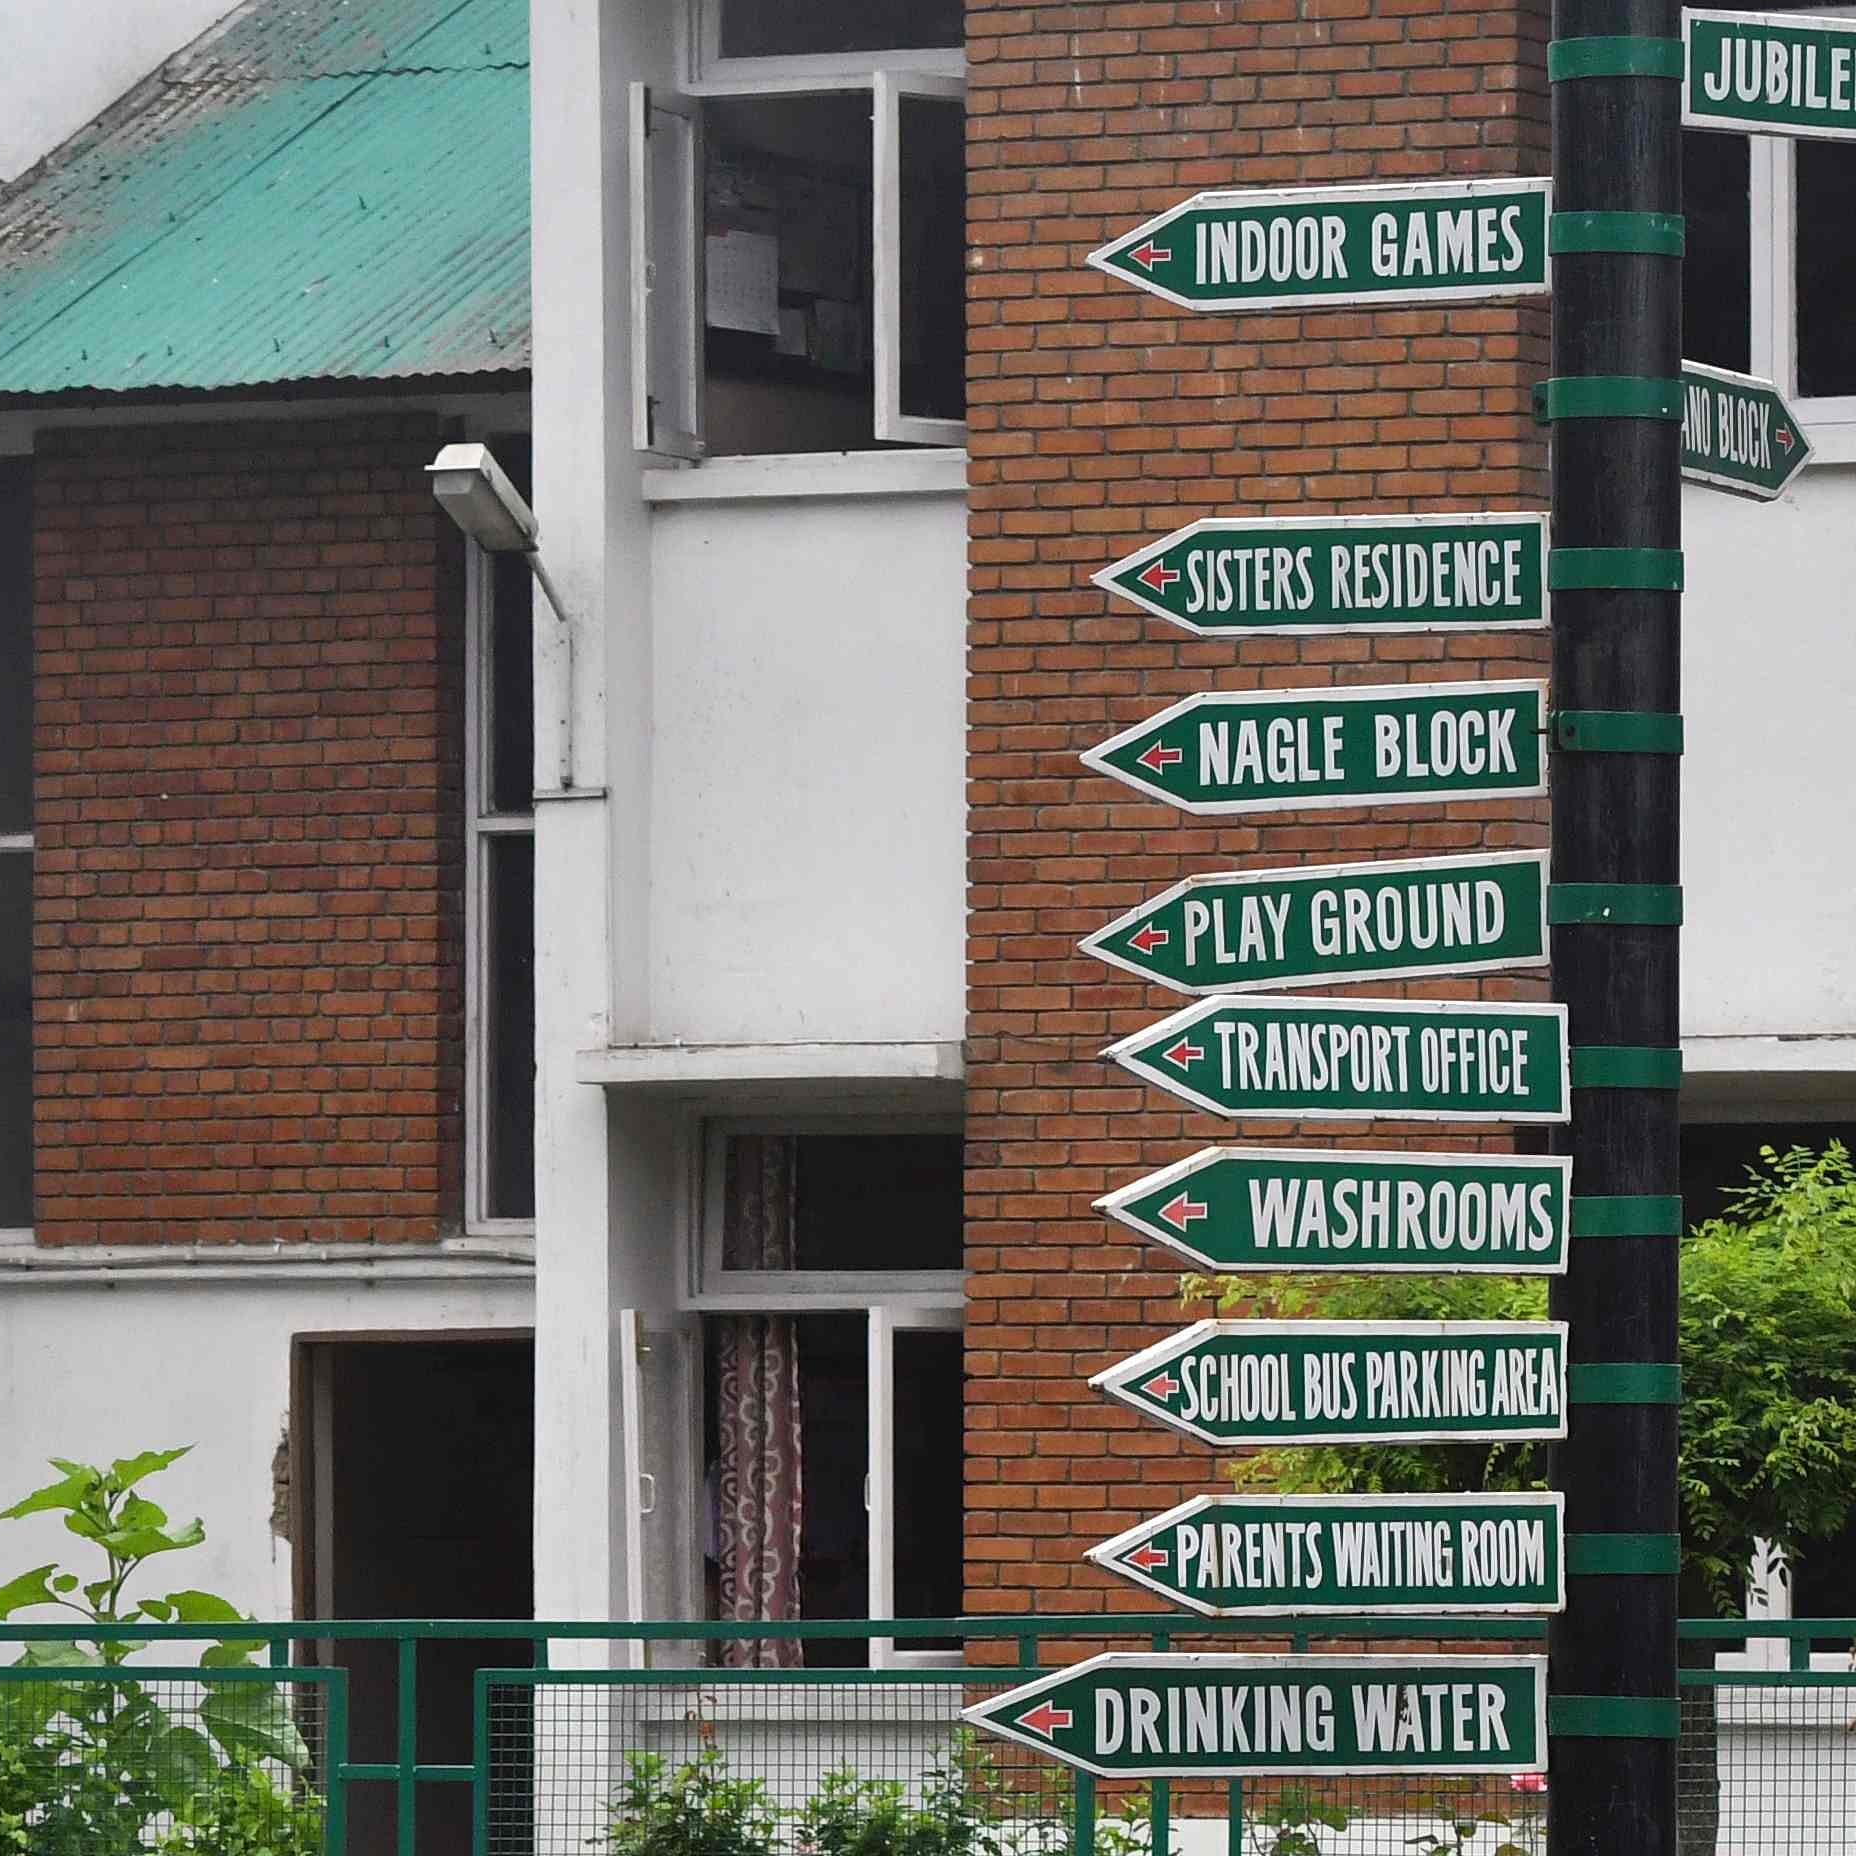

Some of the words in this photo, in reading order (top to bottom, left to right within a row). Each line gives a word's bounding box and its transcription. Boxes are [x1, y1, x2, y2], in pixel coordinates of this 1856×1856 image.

[1196, 215, 1347, 284] INDOOR
[1371, 206, 1523, 276] GAMES
[1717, 392, 1772, 470] BLOCK
[1187, 547, 1313, 612] SISTERS
[1332, 540, 1521, 608] RESIDENCE
[1200, 717, 1344, 785] NAGLE
[1375, 709, 1516, 777] BLOCK
[1183, 888, 1291, 966] PLAY
[1311, 880, 1505, 955] GROUND
[1214, 1022, 1409, 1091] TRANSPORT
[1421, 1028, 1529, 1094] OFFICE
[1249, 1179, 1553, 1251] WASHROOMS
[1180, 1356, 1296, 1421] SCHOOL
[1304, 1353, 1357, 1419] BUS
[1367, 1350, 1486, 1418] PARKING
[1492, 1348, 1558, 1416] AREA
[1177, 1524, 1322, 1588] PARENTS
[1332, 1521, 1452, 1586] WAITING
[1461, 1520, 1544, 1586] ROOM
[1096, 1686, 1334, 1754] DRINKING
[1352, 1684, 1510, 1752] WATER
